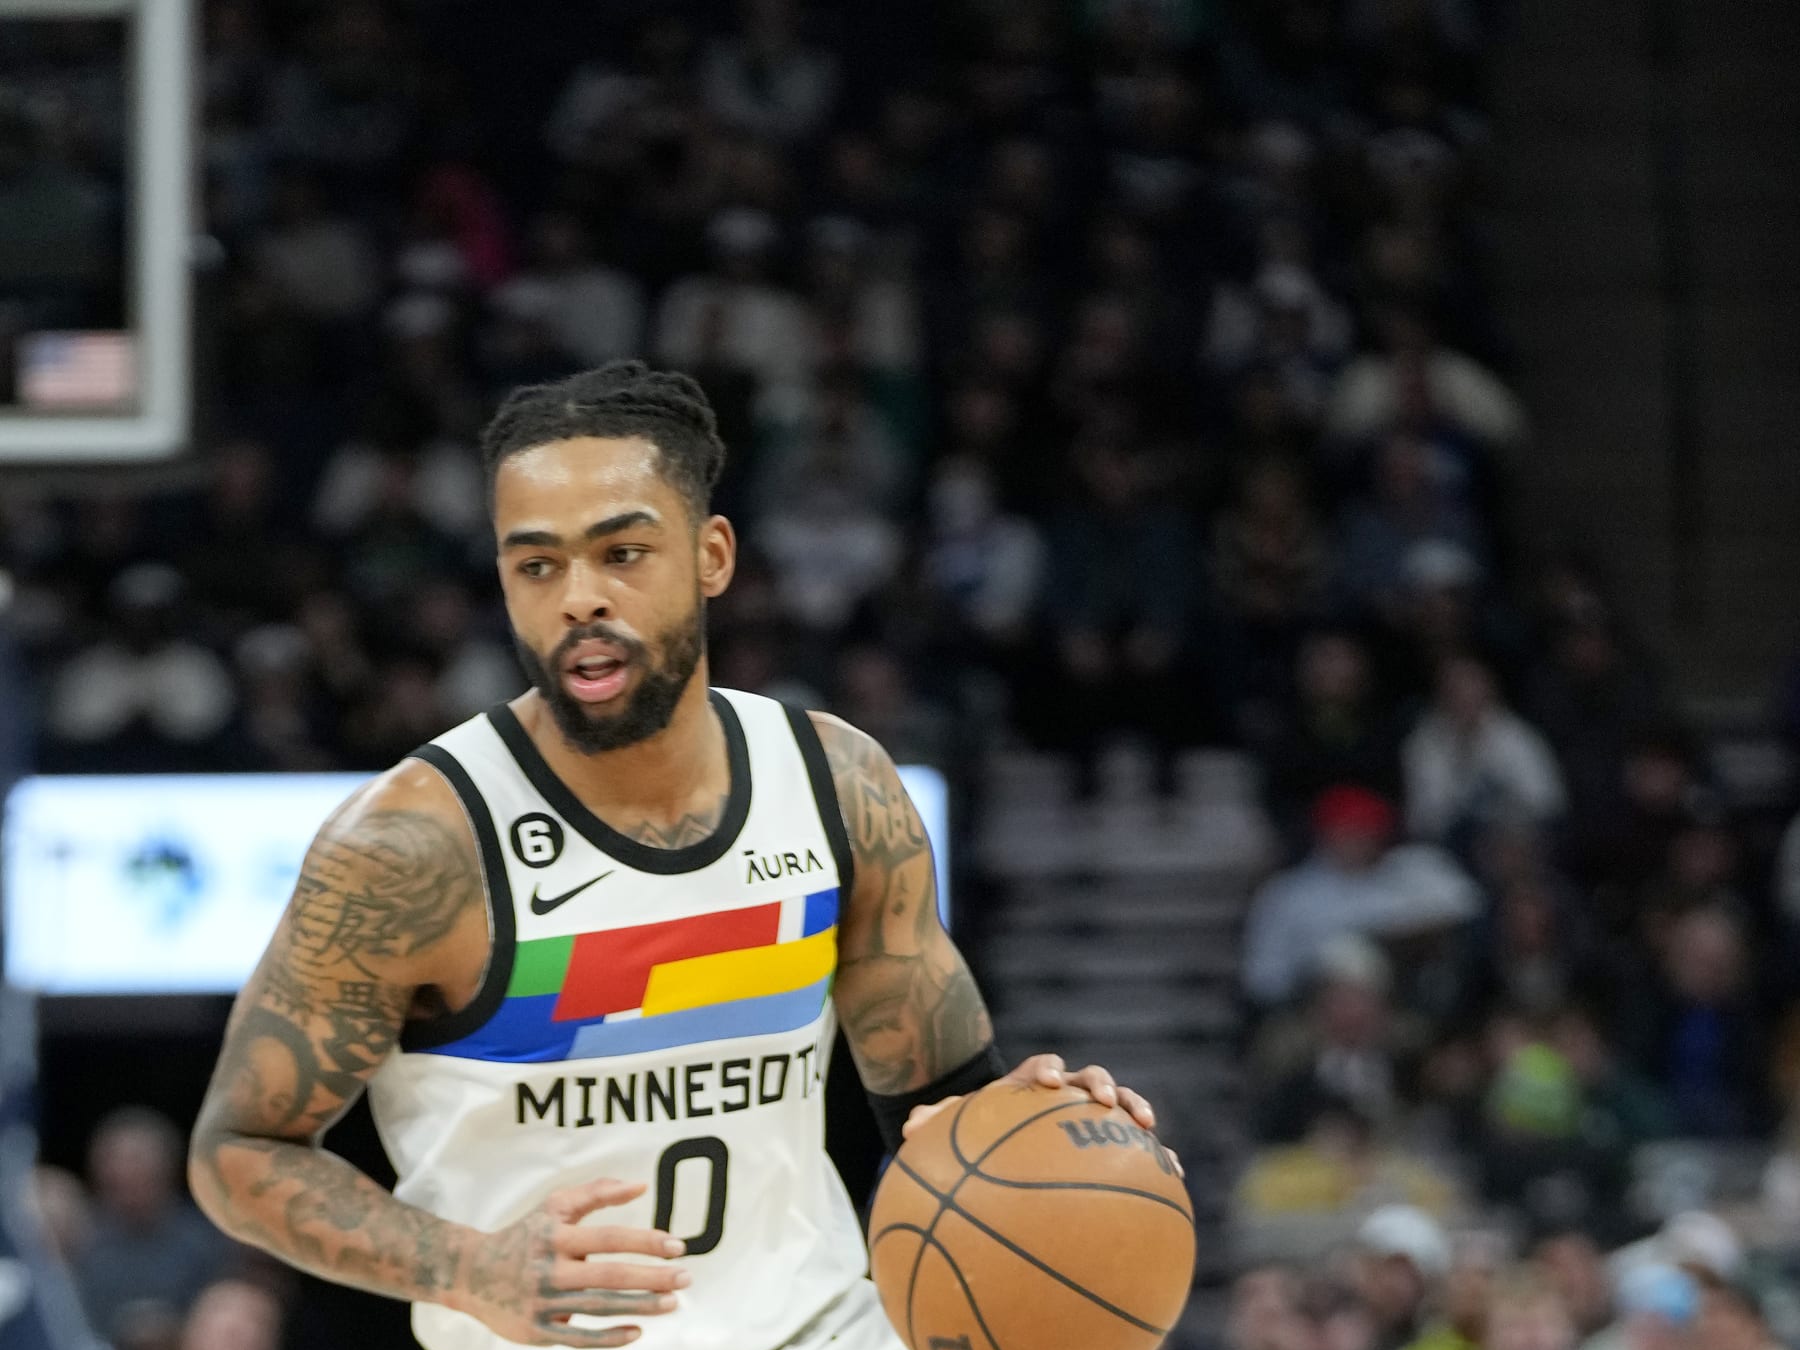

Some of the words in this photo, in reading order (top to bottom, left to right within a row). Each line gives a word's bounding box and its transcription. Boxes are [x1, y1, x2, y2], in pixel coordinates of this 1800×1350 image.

[517, 818, 558, 865] 6
[514, 1042, 823, 1129] MINNESOT
[652, 1135, 729, 1257] 0
